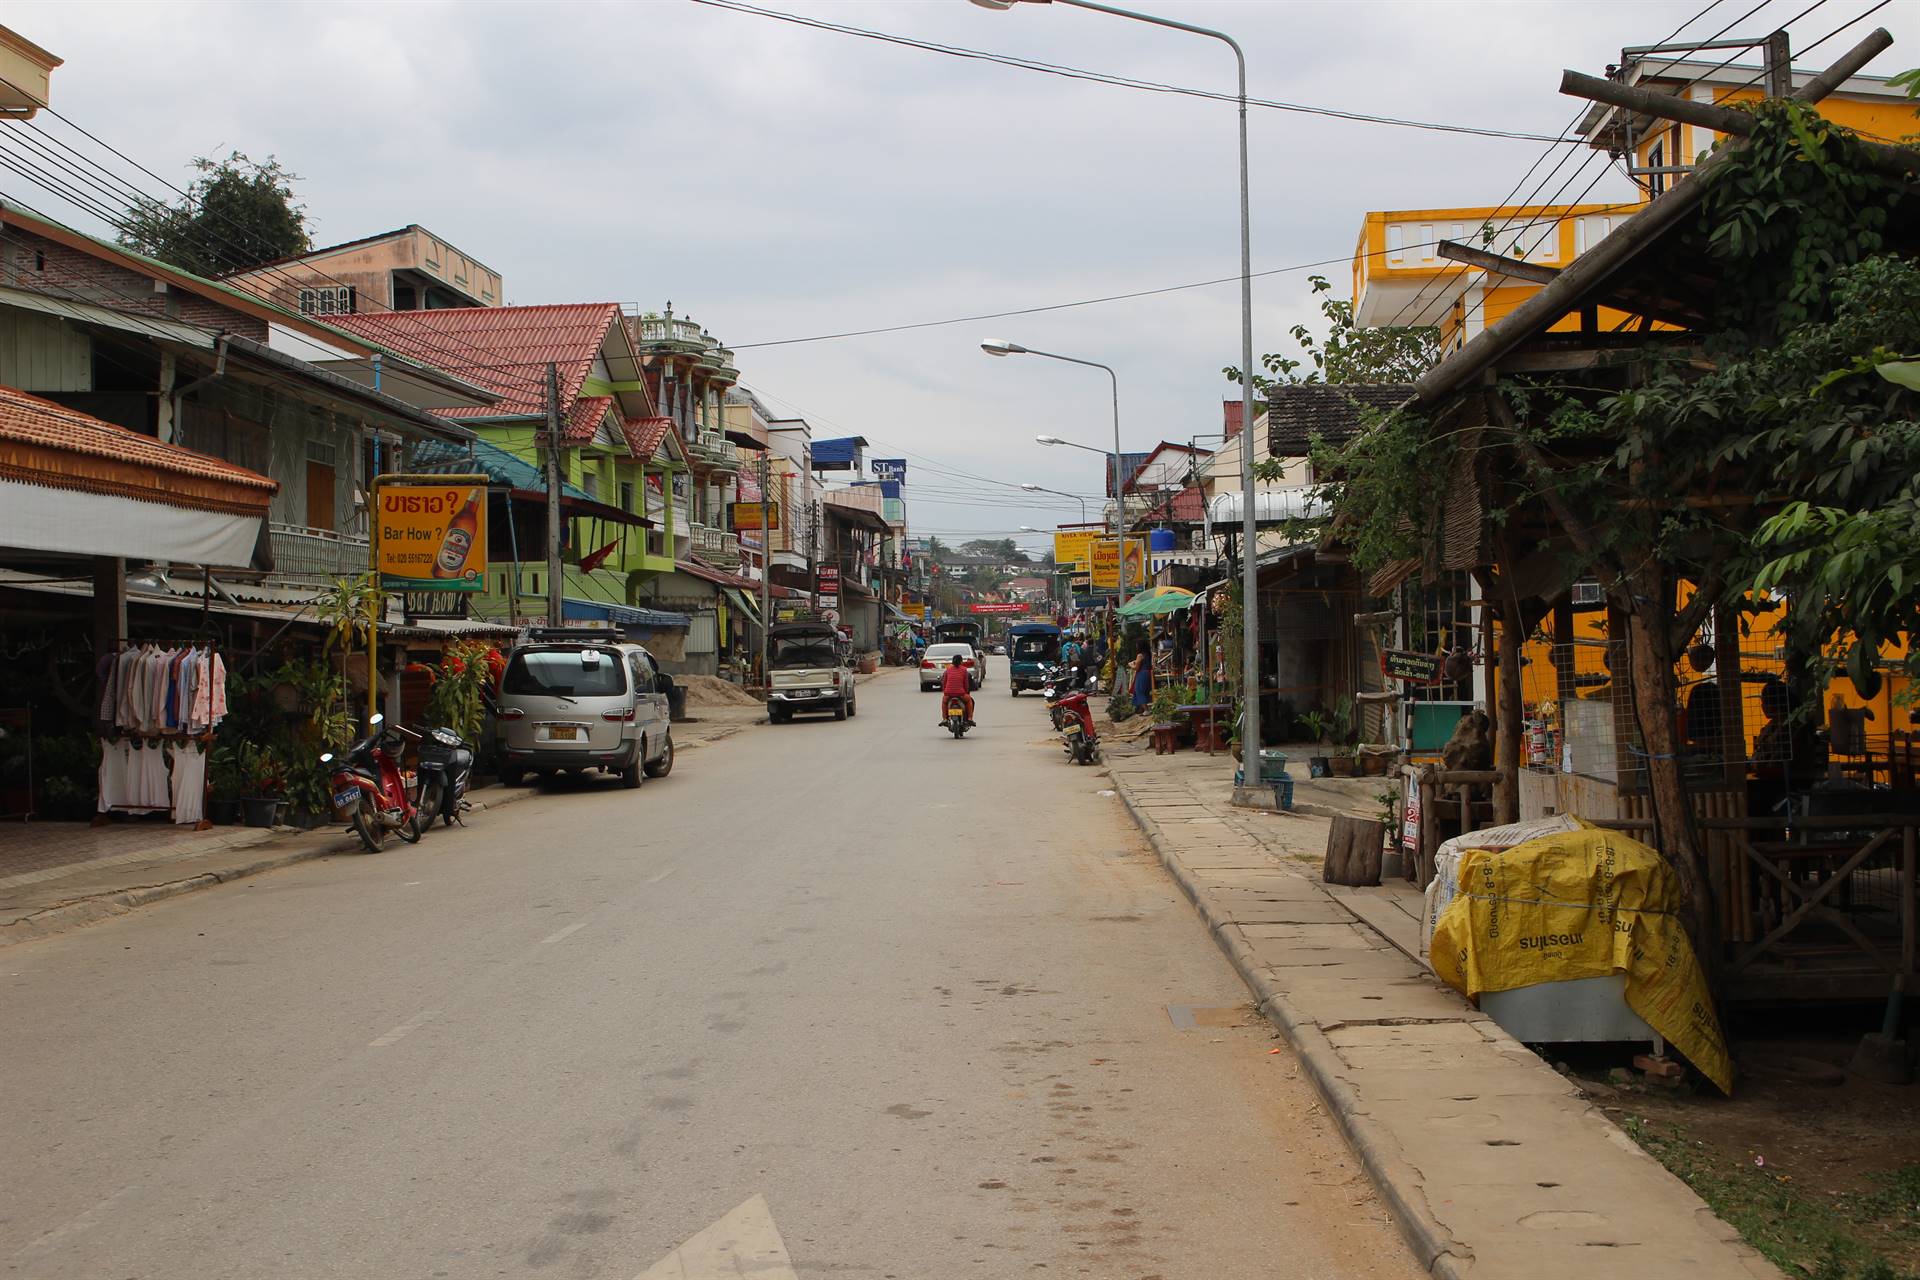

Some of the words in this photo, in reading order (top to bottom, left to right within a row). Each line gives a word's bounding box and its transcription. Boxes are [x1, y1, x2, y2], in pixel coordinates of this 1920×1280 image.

[873, 463, 888, 472] ST
[384, 527, 404, 540] Bar
[407, 527, 432, 540] How
[435, 527, 442, 540] ?
